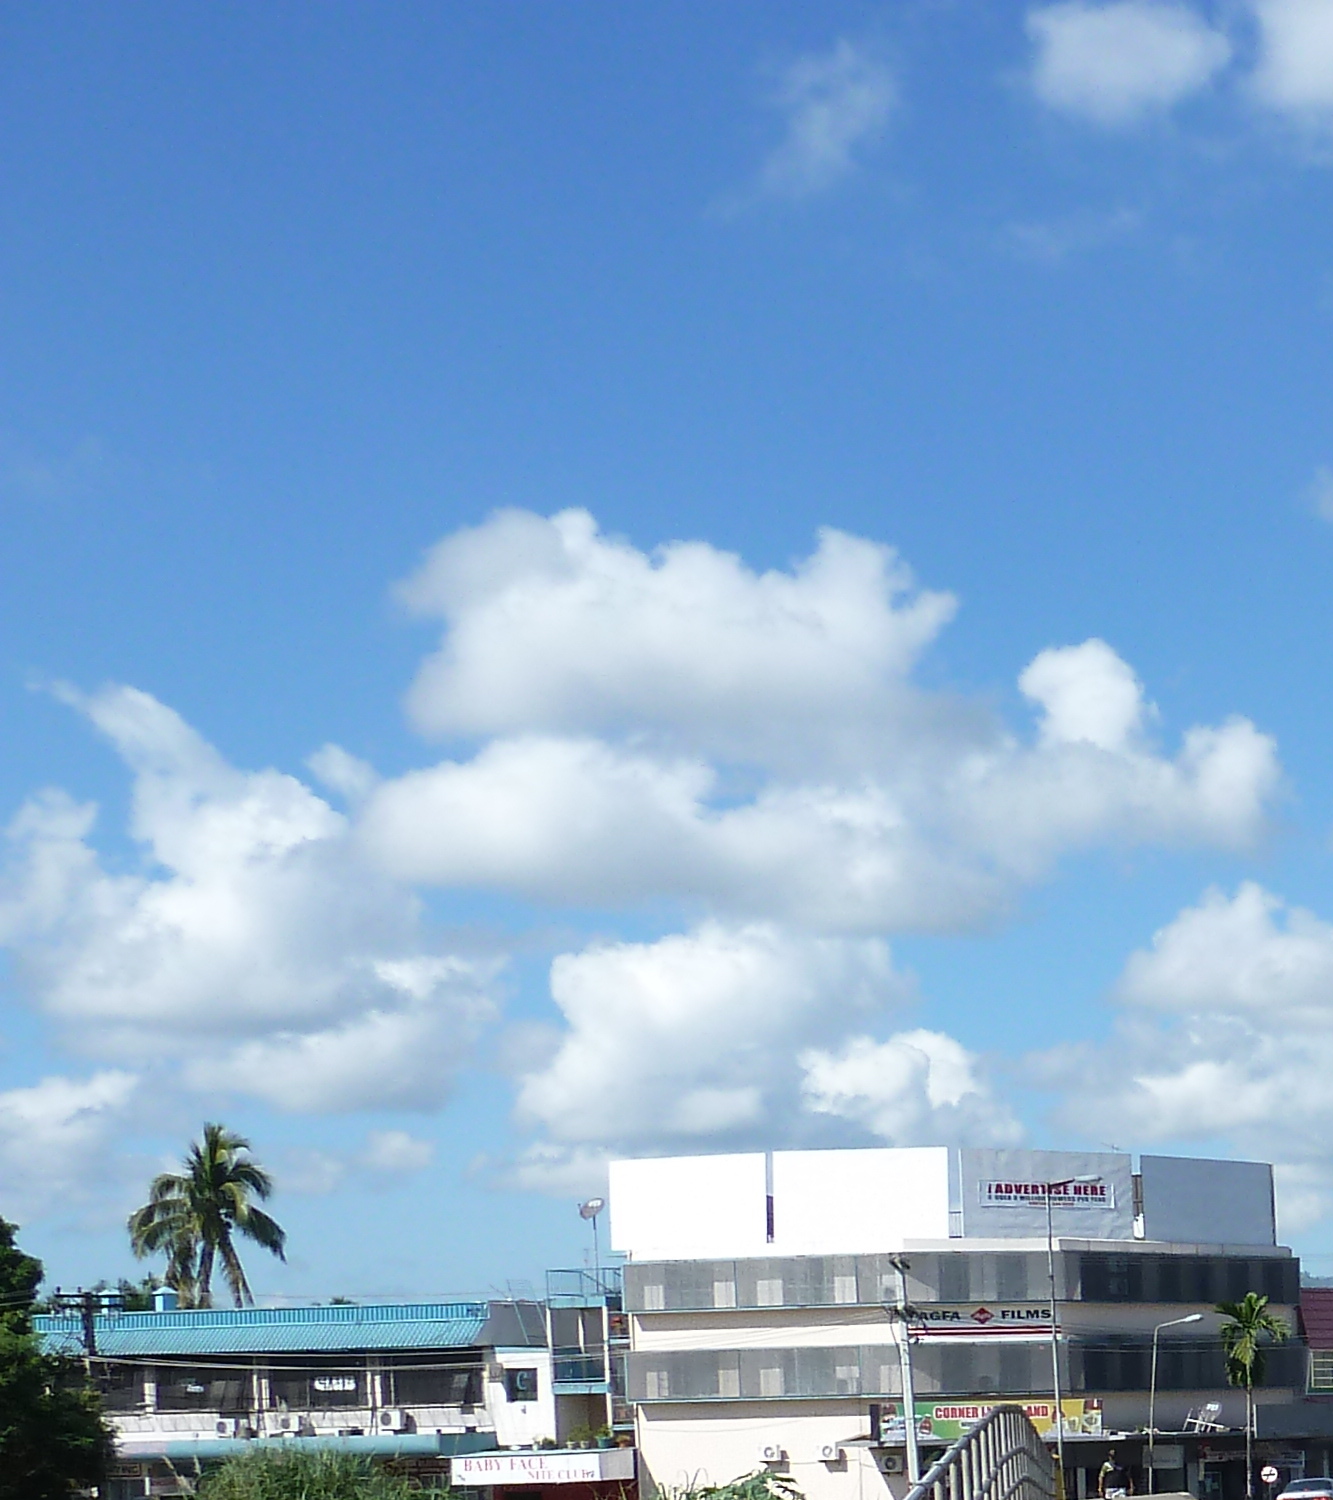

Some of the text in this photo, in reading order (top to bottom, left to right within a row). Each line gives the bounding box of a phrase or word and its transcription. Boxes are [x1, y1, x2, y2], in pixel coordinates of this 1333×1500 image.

[1073, 1184, 1106, 1196] HERE
[918, 1310, 961, 1321] AGFA
[1001, 1309, 1051, 1320] FILMS
[935, 1406, 979, 1419] CORNER
[464, 1456, 548, 1472] BABY FACE
[528, 1469, 555, 1480] NITE
